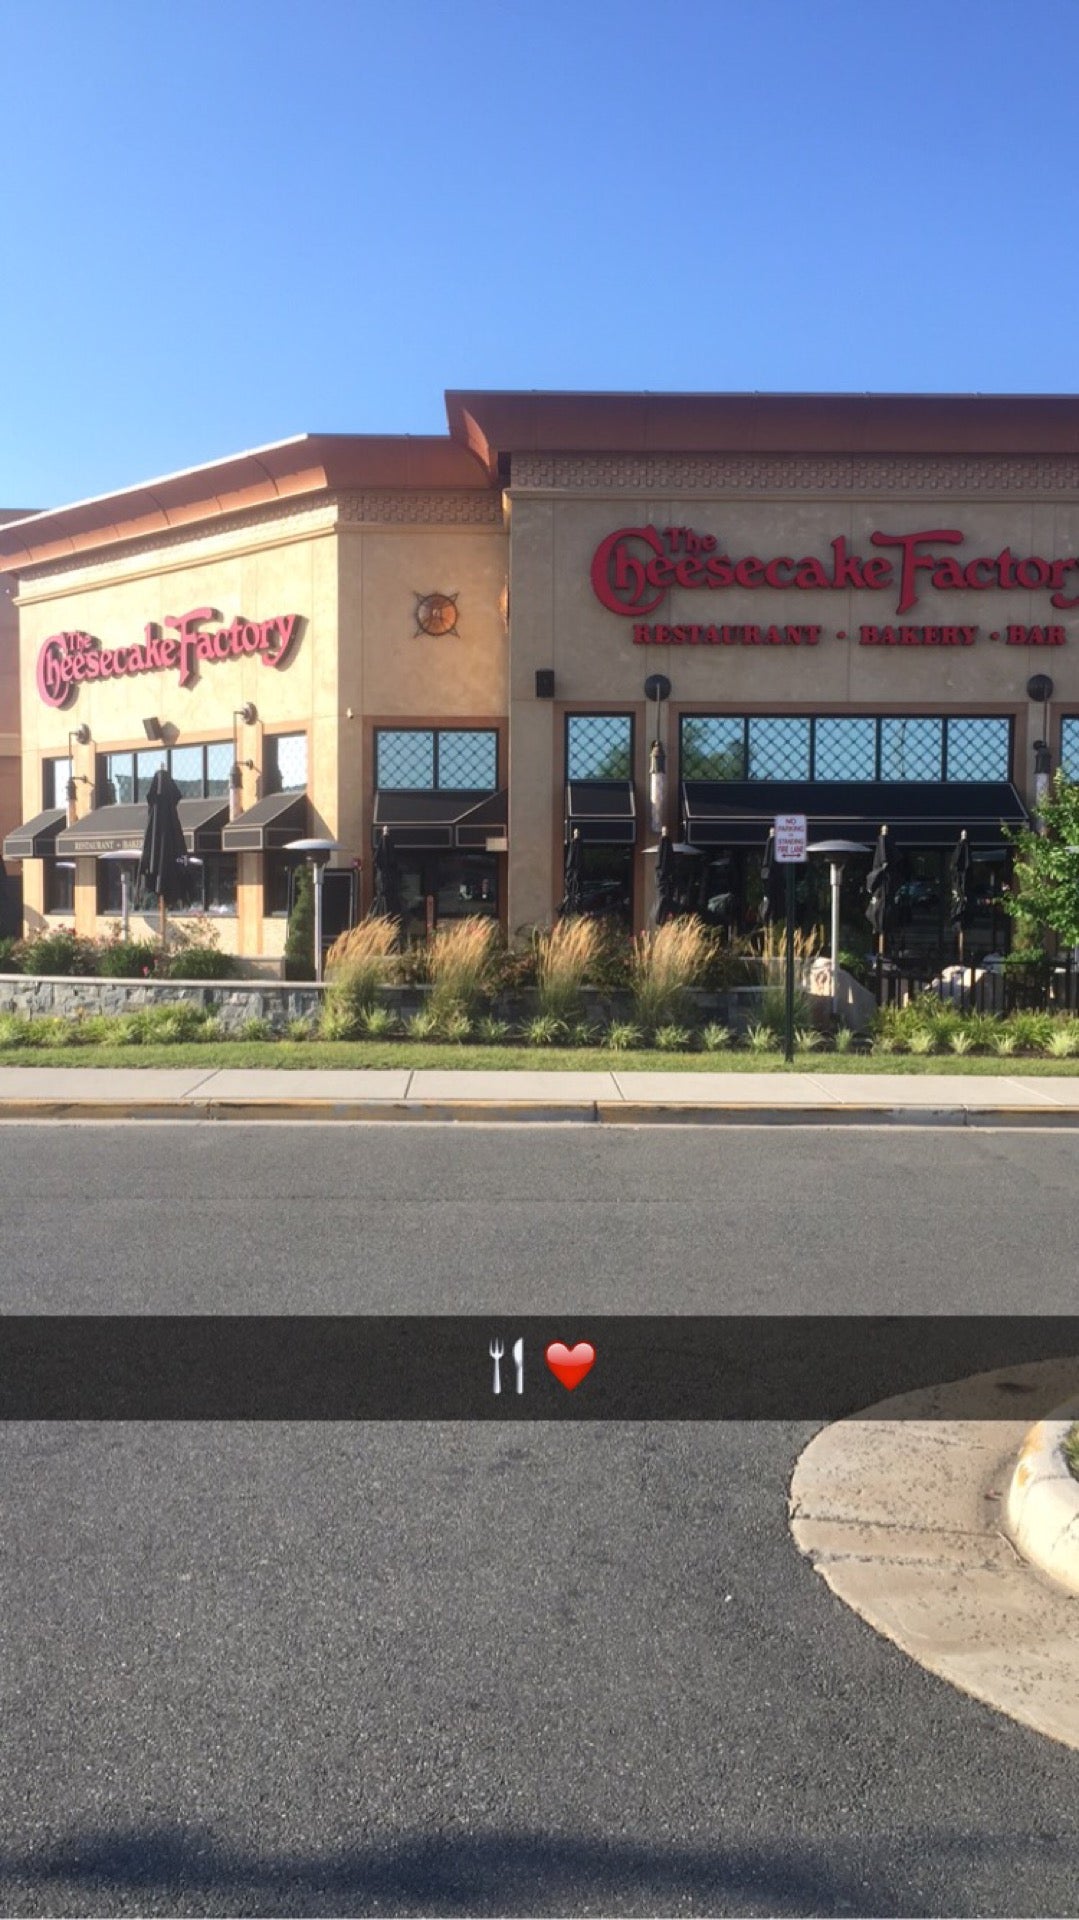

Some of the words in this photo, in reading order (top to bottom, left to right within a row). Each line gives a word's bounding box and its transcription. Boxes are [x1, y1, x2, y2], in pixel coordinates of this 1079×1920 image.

[663, 526, 718, 553] The
[590, 524, 893, 617] Cheesecake
[66, 631, 92, 651] The
[164, 606, 299, 687] Factory
[633, 624, 822, 645] RESTAURANT
[859, 625, 978, 646] BAKERY
[1005, 625, 1066, 646] BAR
[36, 621, 176, 708] Cheesecake
